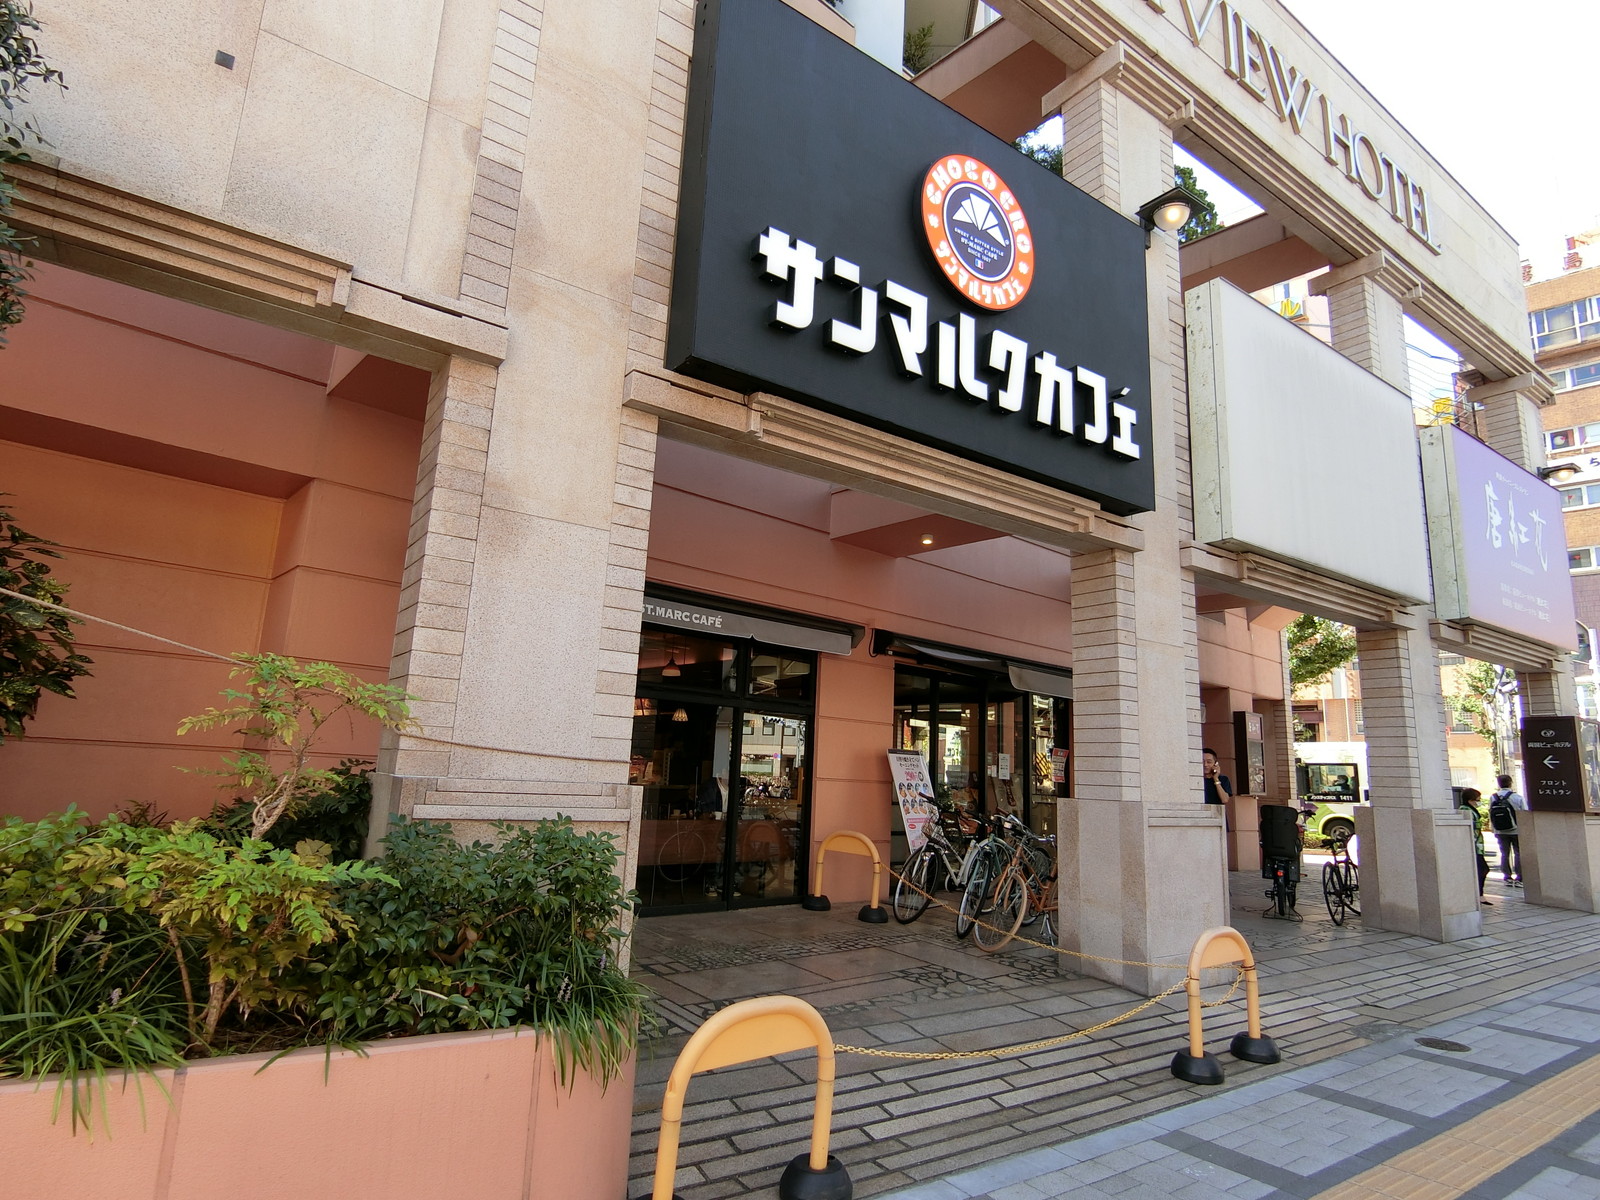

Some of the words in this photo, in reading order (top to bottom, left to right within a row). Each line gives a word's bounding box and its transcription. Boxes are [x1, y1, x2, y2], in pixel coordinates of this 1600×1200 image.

[1178, 0, 1318, 135] VIEW
[1319, 93, 1441, 256] HOTEL
[926, 159, 996, 205] CHOCO
[999, 191, 1031, 254] CRO
[935, 239, 1025, 306] サンマルクカフェ
[757, 225, 1140, 461] サンマルクカフェ
[691, 615, 723, 629] CAFÉ
[1538, 788, 1572, 796] レストラン
